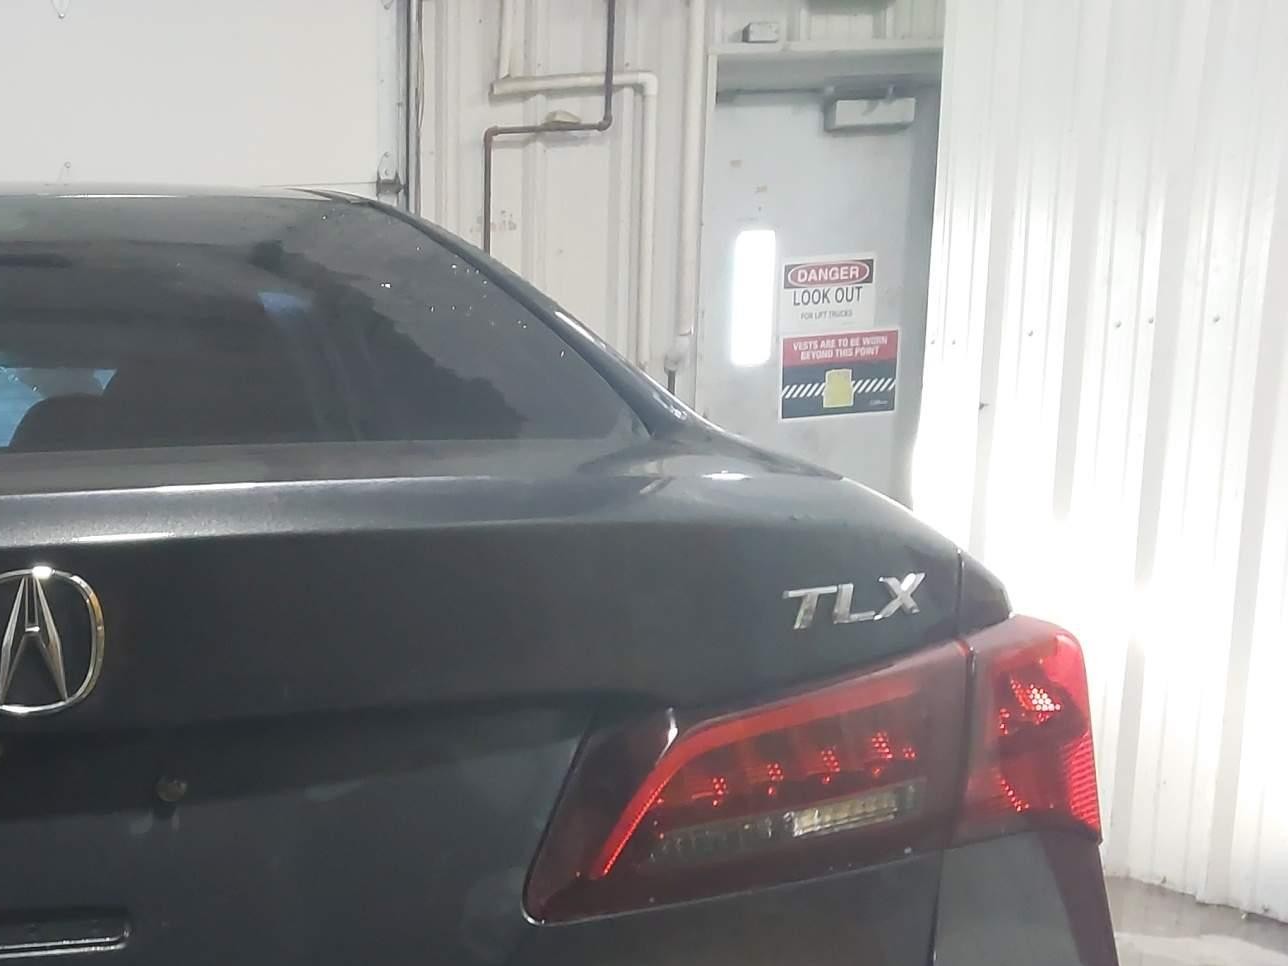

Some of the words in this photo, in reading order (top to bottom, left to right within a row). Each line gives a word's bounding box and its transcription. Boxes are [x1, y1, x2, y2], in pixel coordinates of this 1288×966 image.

[797, 265, 860, 283] DANGER
[793, 287, 831, 306] LOOK
[834, 286, 863, 303] OUT
[800, 311, 813, 320] FOR
[814, 310, 828, 320] LIFT
[829, 309, 853, 319] TRUCKS
[793, 340, 819, 352] VESTS
[820, 339, 836, 349] ARE
[838, 337, 849, 348] TO
[850, 337, 860, 346] BE
[862, 335, 888, 346] WORN
[800, 348, 834, 361] BEYOND
[835, 347, 853, 358] THIS
[854, 345, 880, 357] POINT
[783, 573, 925, 630] TLX
